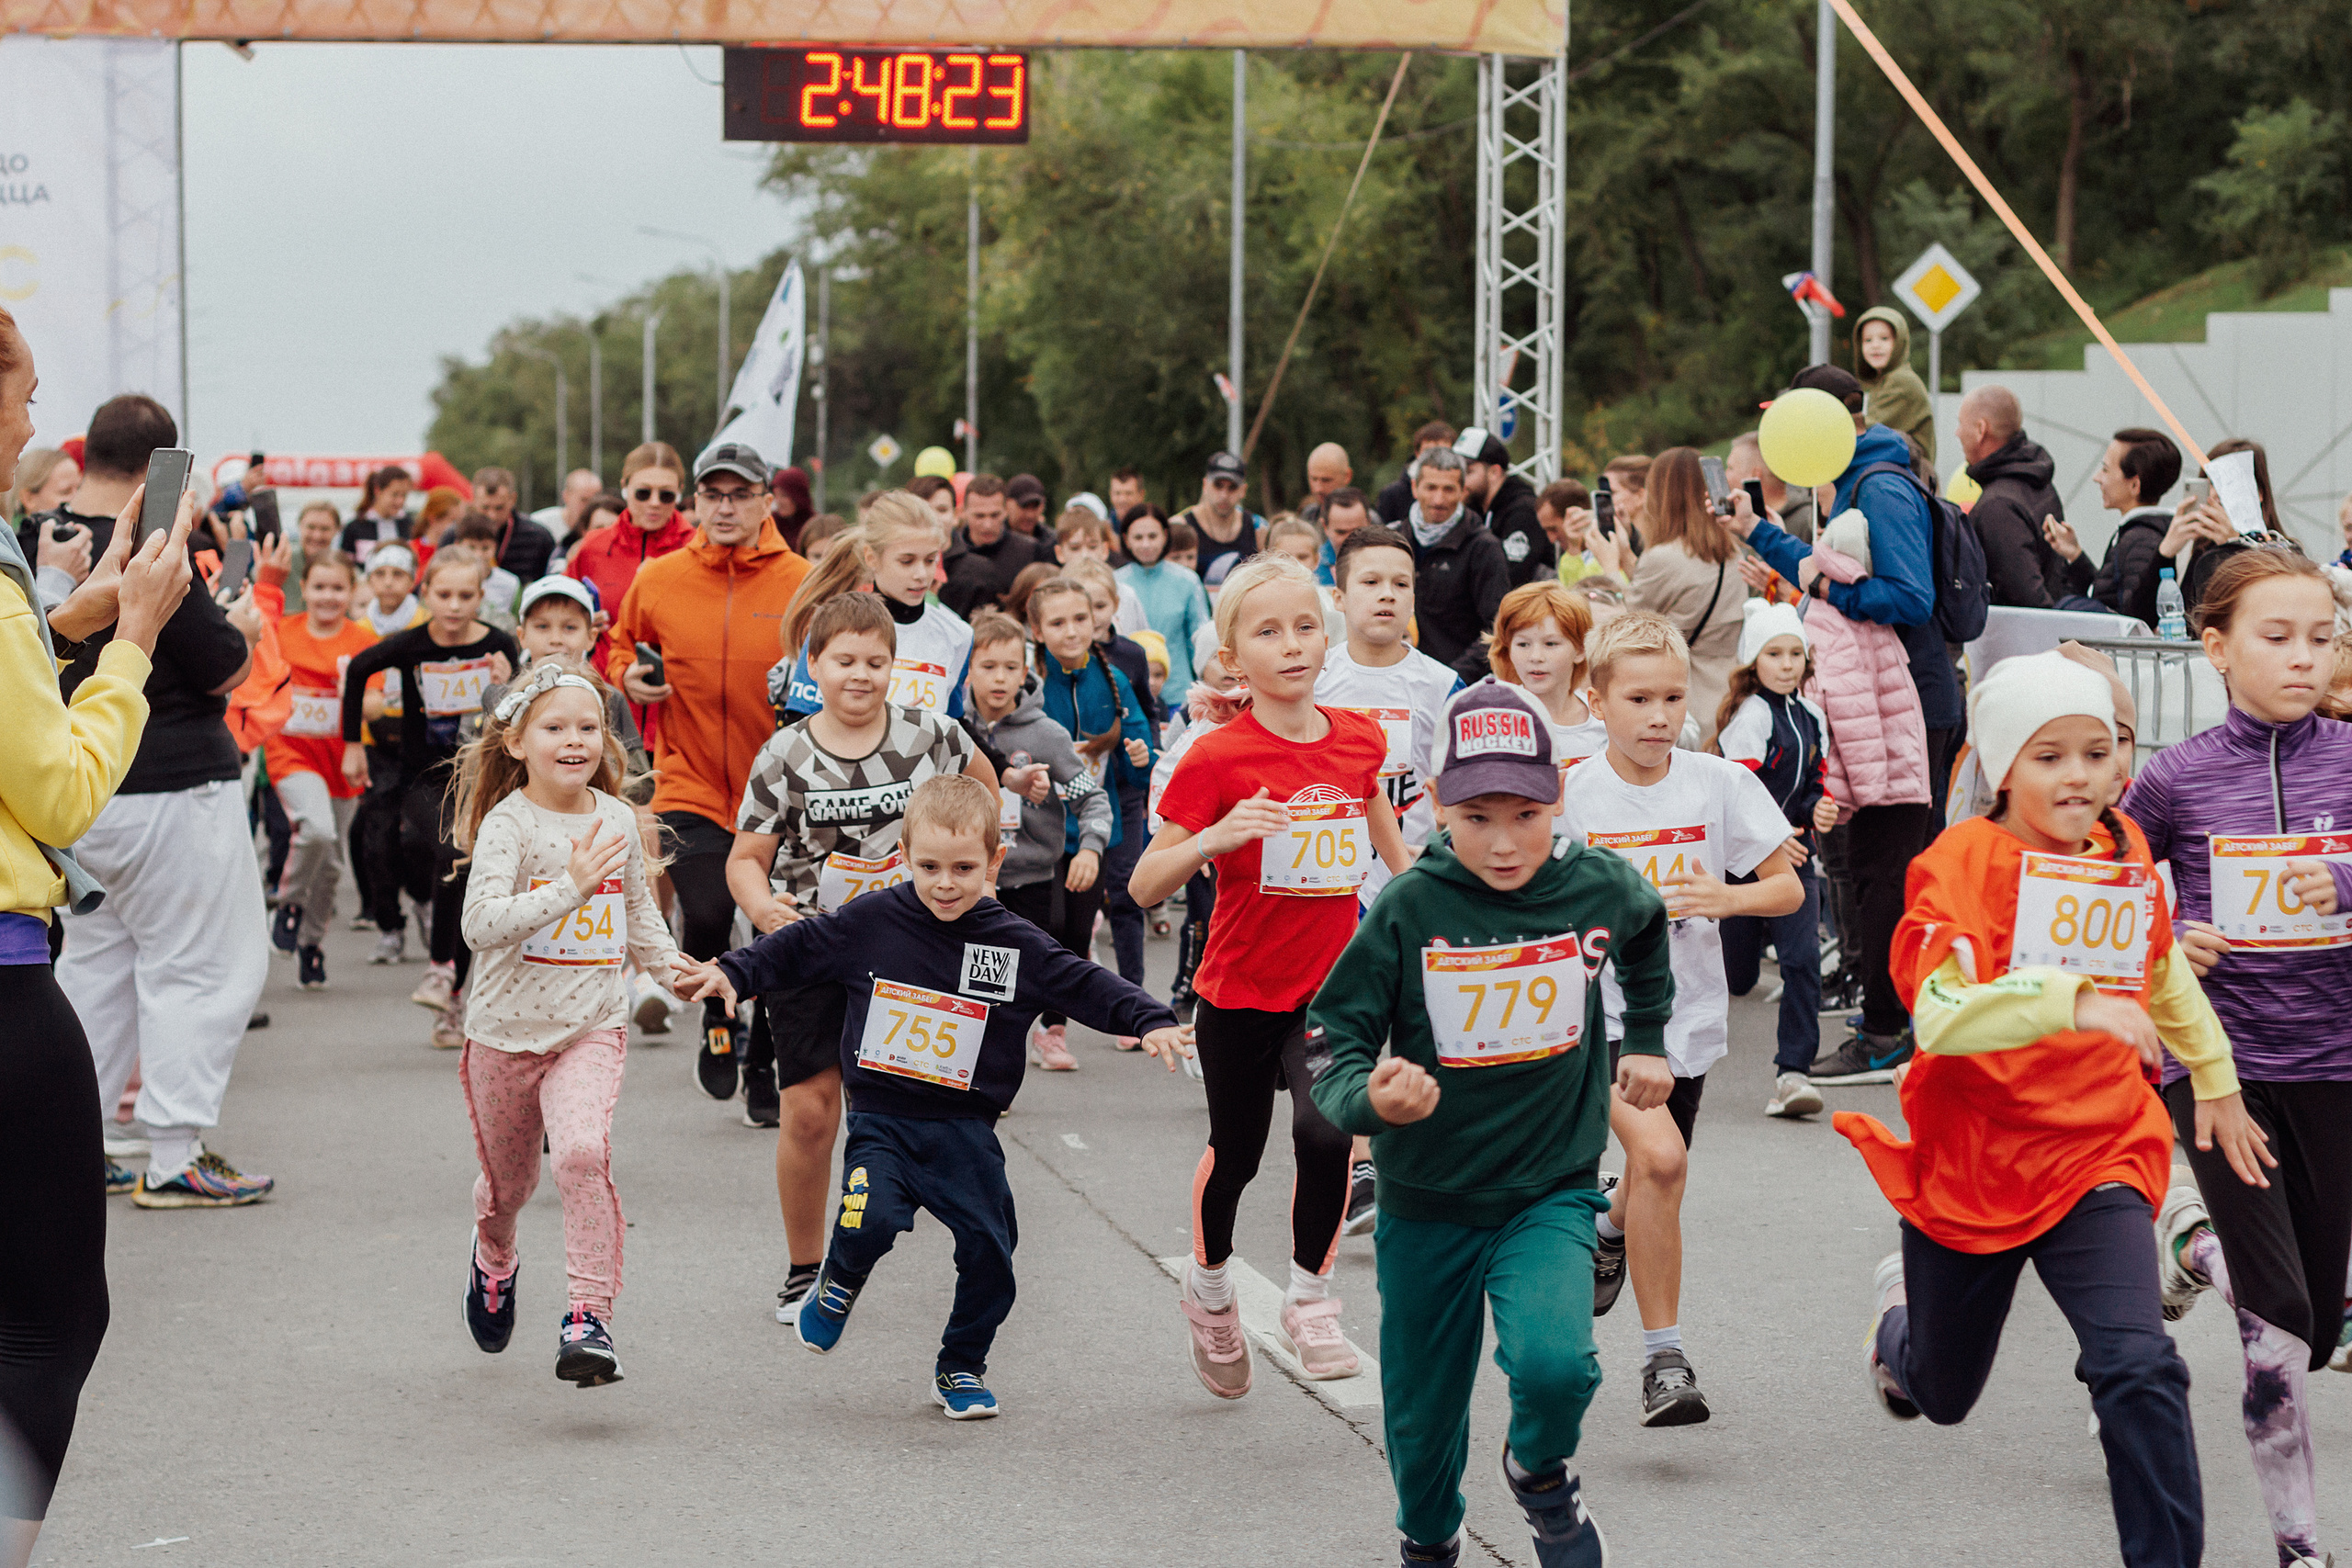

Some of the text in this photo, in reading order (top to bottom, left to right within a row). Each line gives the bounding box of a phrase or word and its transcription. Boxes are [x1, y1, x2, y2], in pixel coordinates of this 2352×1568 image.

[799, 51, 1025, 129] 2:48:23
[439, 676, 481, 699] 741
[1460, 713, 1531, 742] RUSSIA
[1461, 735, 1532, 751] HOCKEY
[808, 789, 913, 822] GAME ON
[1291, 829, 1357, 869] 705
[1594, 833, 1654, 845] ДЕТСКИЙ ЗАБЕГ
[1629, 853, 1689, 891] 44
[2243, 869, 2323, 916] 70
[550, 904, 615, 942] 754
[2050, 894, 2136, 952] 800
[968, 963, 1005, 984] DAY
[972, 947, 1010, 966] NEW
[880, 986, 934, 1003] ДЕТСКИЙ ЗАБЕГ
[1457, 975, 1558, 1032] 779
[883, 1009, 959, 1059] 755
